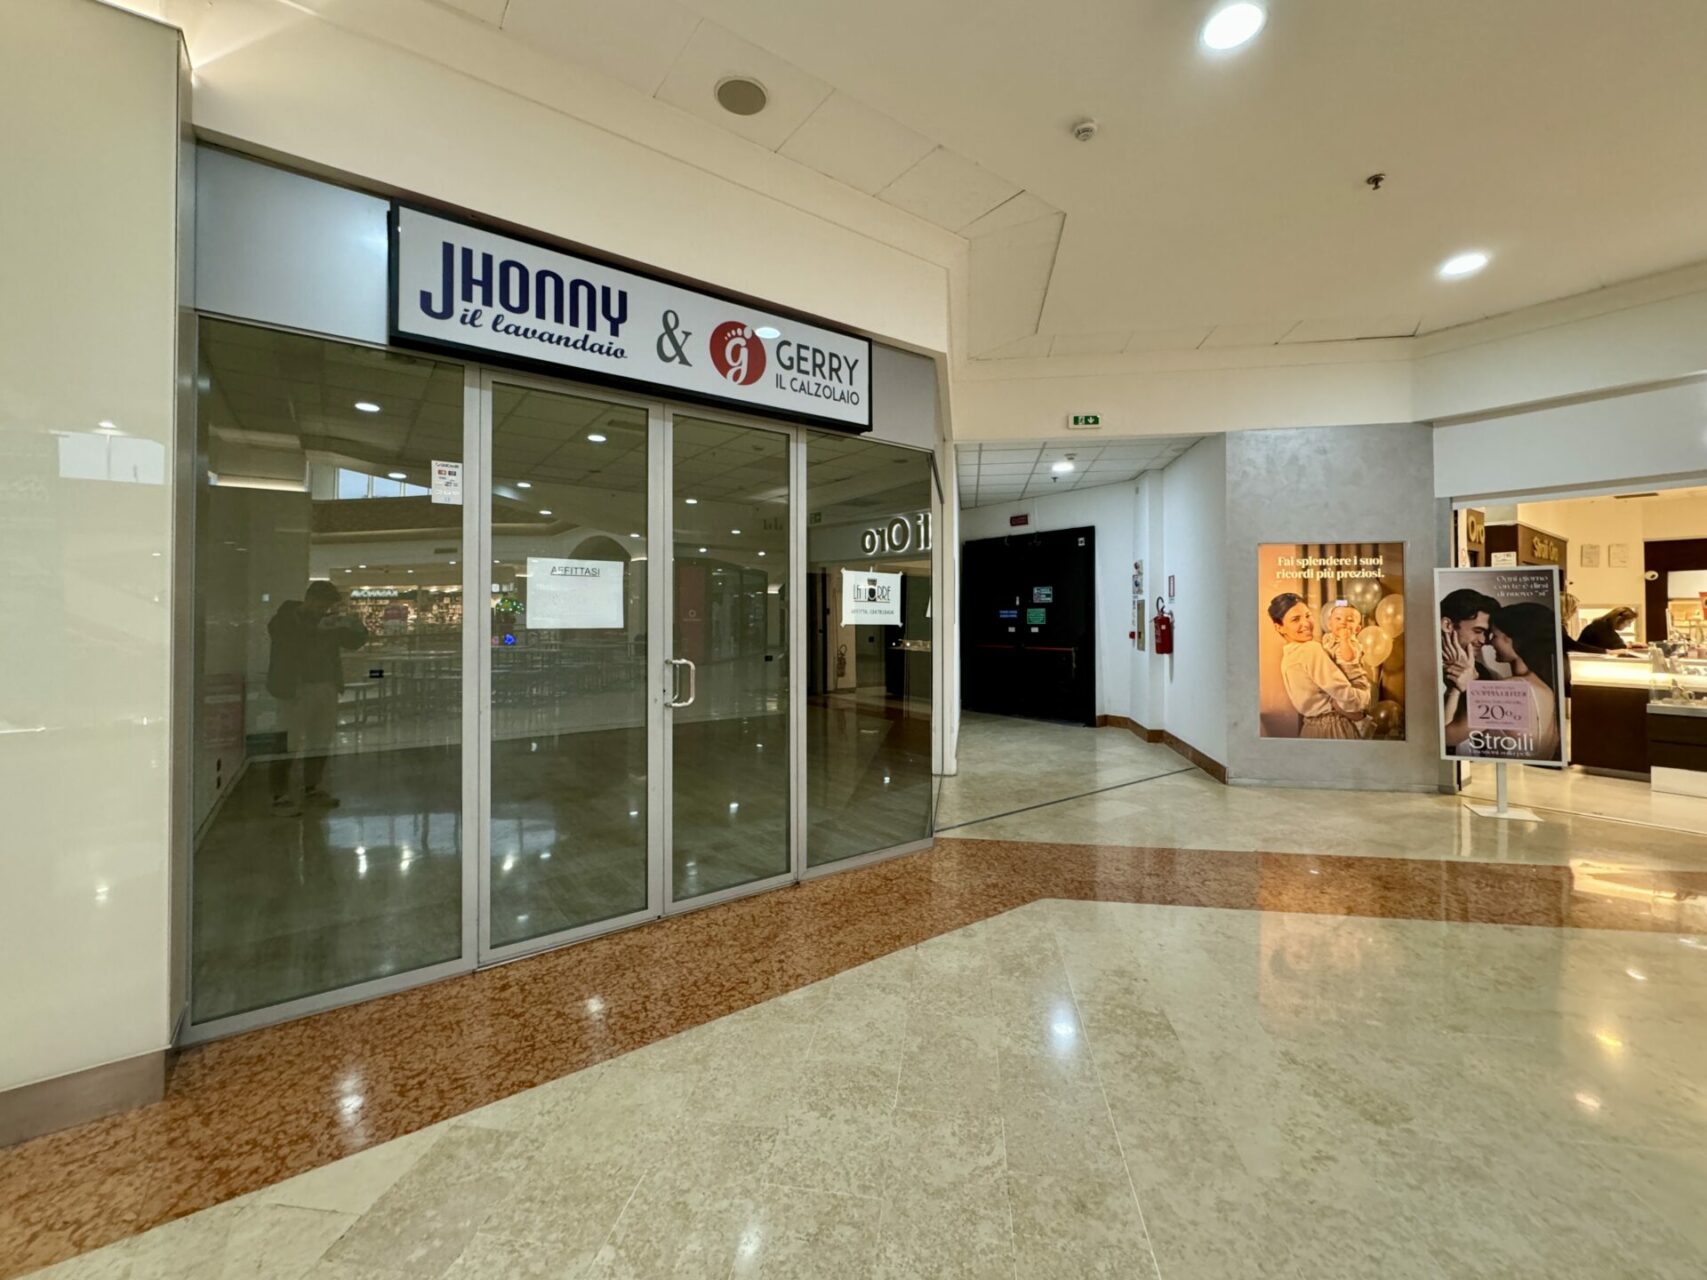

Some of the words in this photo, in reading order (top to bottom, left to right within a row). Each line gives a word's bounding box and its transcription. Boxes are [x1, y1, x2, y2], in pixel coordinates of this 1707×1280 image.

[419, 241, 628, 338] JHONNY
[459, 308, 484, 328] il
[490, 314, 628, 359] lavandaio
[656, 309, 694, 368] &
[775, 340, 861, 386] GERRY
[774, 373, 788, 391] IL
[790, 377, 861, 407] CALZOLAIO
[550, 565, 601, 577] AFFITTASI
[1276, 568, 1314, 579] ricordi
[1316, 567, 1334, 581] più
[1336, 567, 1385, 581] preziosi.
[1277, 556, 1294, 566] Fai
[1296, 555, 1352, 568] splendere
[1359, 555, 1383, 566] suoi
[1469, 730, 1534, 752] Stroili
